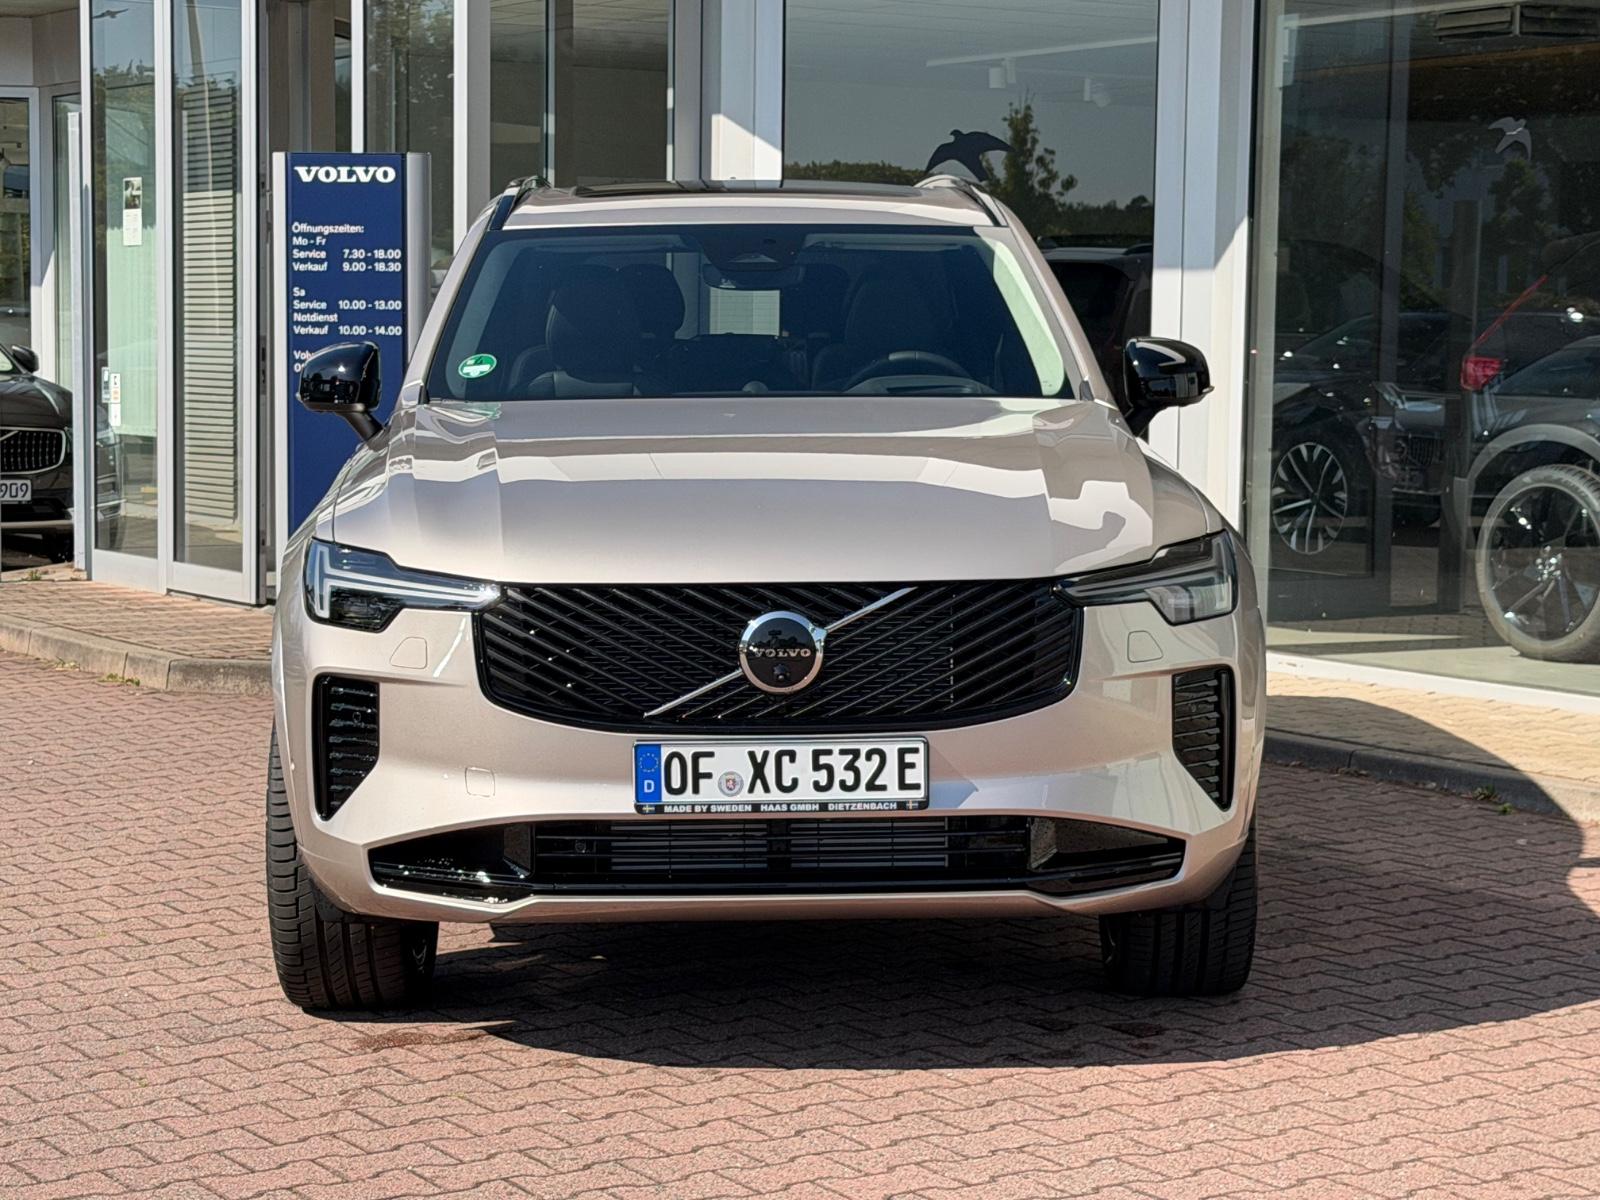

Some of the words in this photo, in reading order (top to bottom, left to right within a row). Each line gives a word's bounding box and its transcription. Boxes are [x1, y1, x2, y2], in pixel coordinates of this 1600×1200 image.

[294, 165, 396, 184] VOLVO
[292, 221, 364, 236] Öffnungszeiten:
[292, 236, 308, 246] Mo
[316, 236, 326, 246] Fr
[292, 249, 326, 259] Service
[342, 249, 365, 259] 7.30
[374, 249, 402, 259] 18.00
[292, 261, 328, 271] Verkauf
[342, 262, 366, 272] 9.00
[374, 262, 402, 272] 18.30
[293, 287, 306, 297] Sa
[293, 300, 327, 310] Service
[338, 300, 366, 310] 10.00
[374, 300, 402, 310] 13.00
[293, 313, 338, 322] Notdienst
[293, 325, 329, 335] Verkauf
[338, 325, 366, 335] 10.00
[374, 326, 402, 335] 14.00
[754, 648, 811, 658] VOLVO
[664, 751, 715, 796] OF
[747, 749, 799, 794] XC
[644, 780, 655, 793] D
[663, 804, 692, 813] MADE
[694, 804, 709, 813] BY
[710, 804, 752, 813] SWEDEN
[760, 803, 788, 812] HAAS
[789, 803, 820, 812] GMBH
[827, 802, 897, 812] DIETZENBACH
